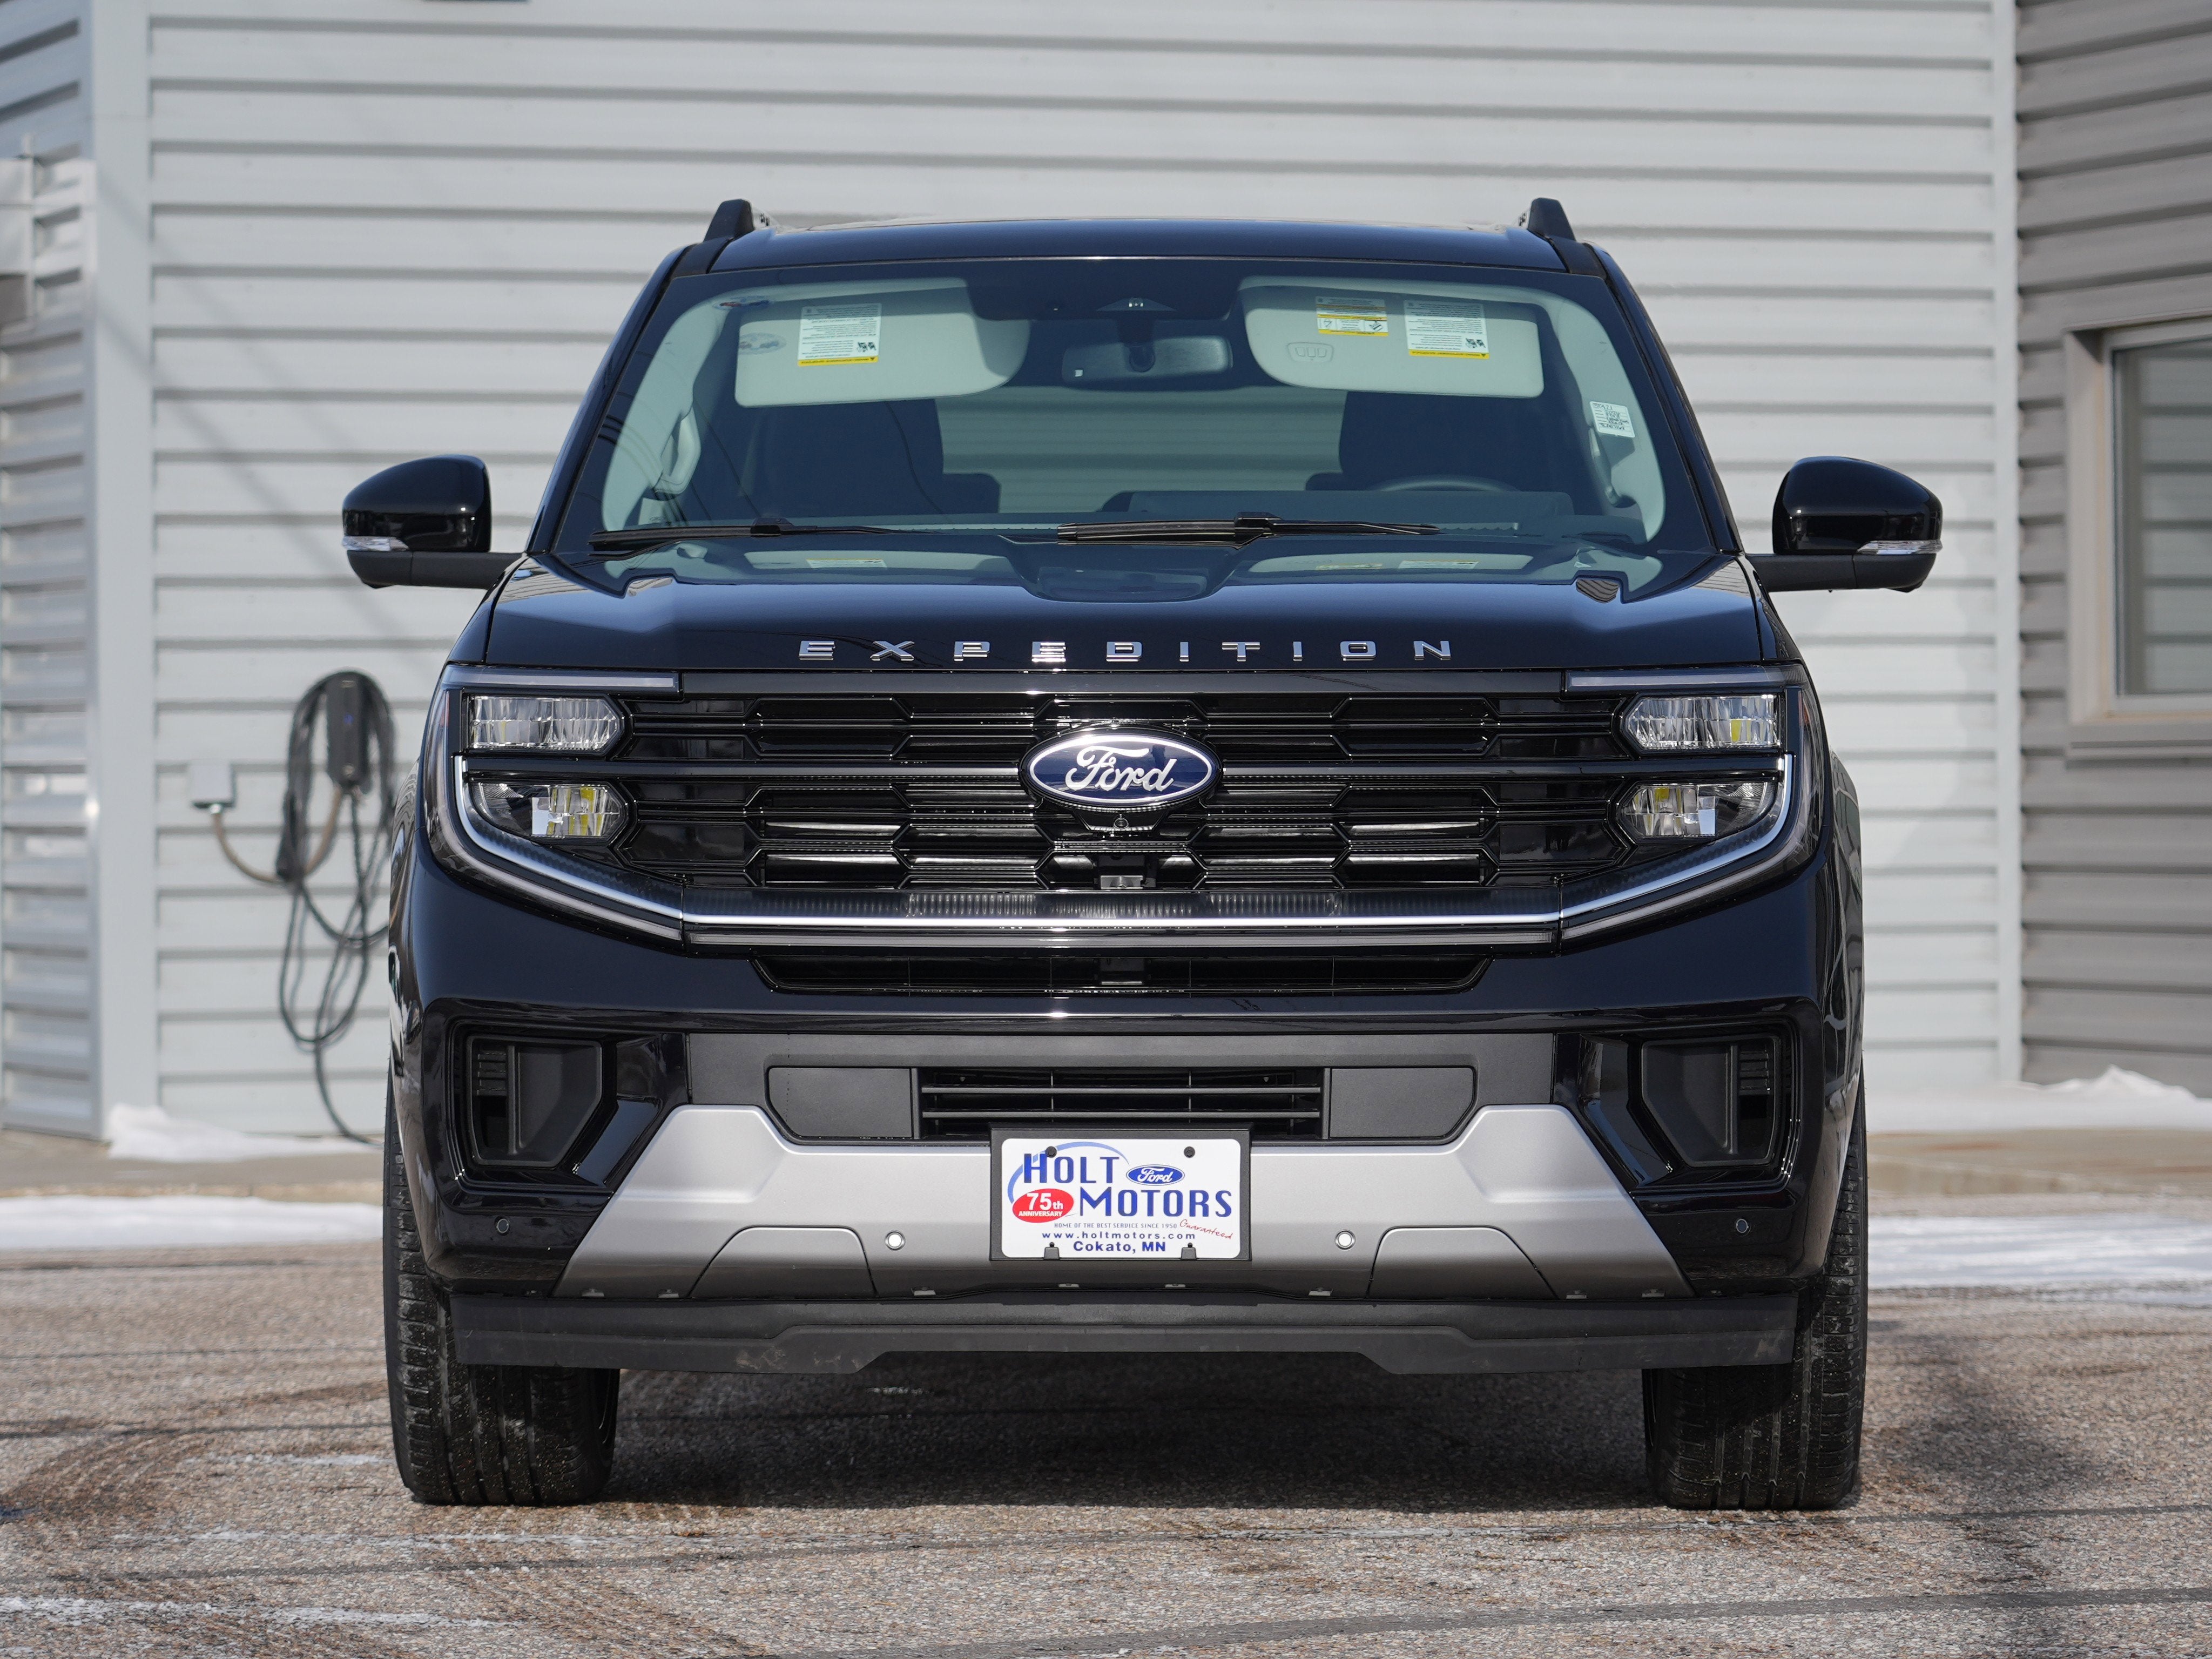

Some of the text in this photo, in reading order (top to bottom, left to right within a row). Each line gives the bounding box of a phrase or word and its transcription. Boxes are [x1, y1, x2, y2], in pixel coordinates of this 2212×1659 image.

[798, 640, 1452, 663] EXPEDITION
[1064, 745, 1177, 792] Ford
[1023, 1154, 1120, 1184] HOLT
[1138, 1166, 1174, 1183] Ford
[1027, 1193, 1064, 1211] 75th
[1080, 1186, 1232, 1217] MOTORS
[1042, 1231, 1196, 1239] www.holtmotors.com
[1179, 1219, 1233, 1240] Guaranteed
[1073, 1241, 1166, 1254] Cokato, MN
